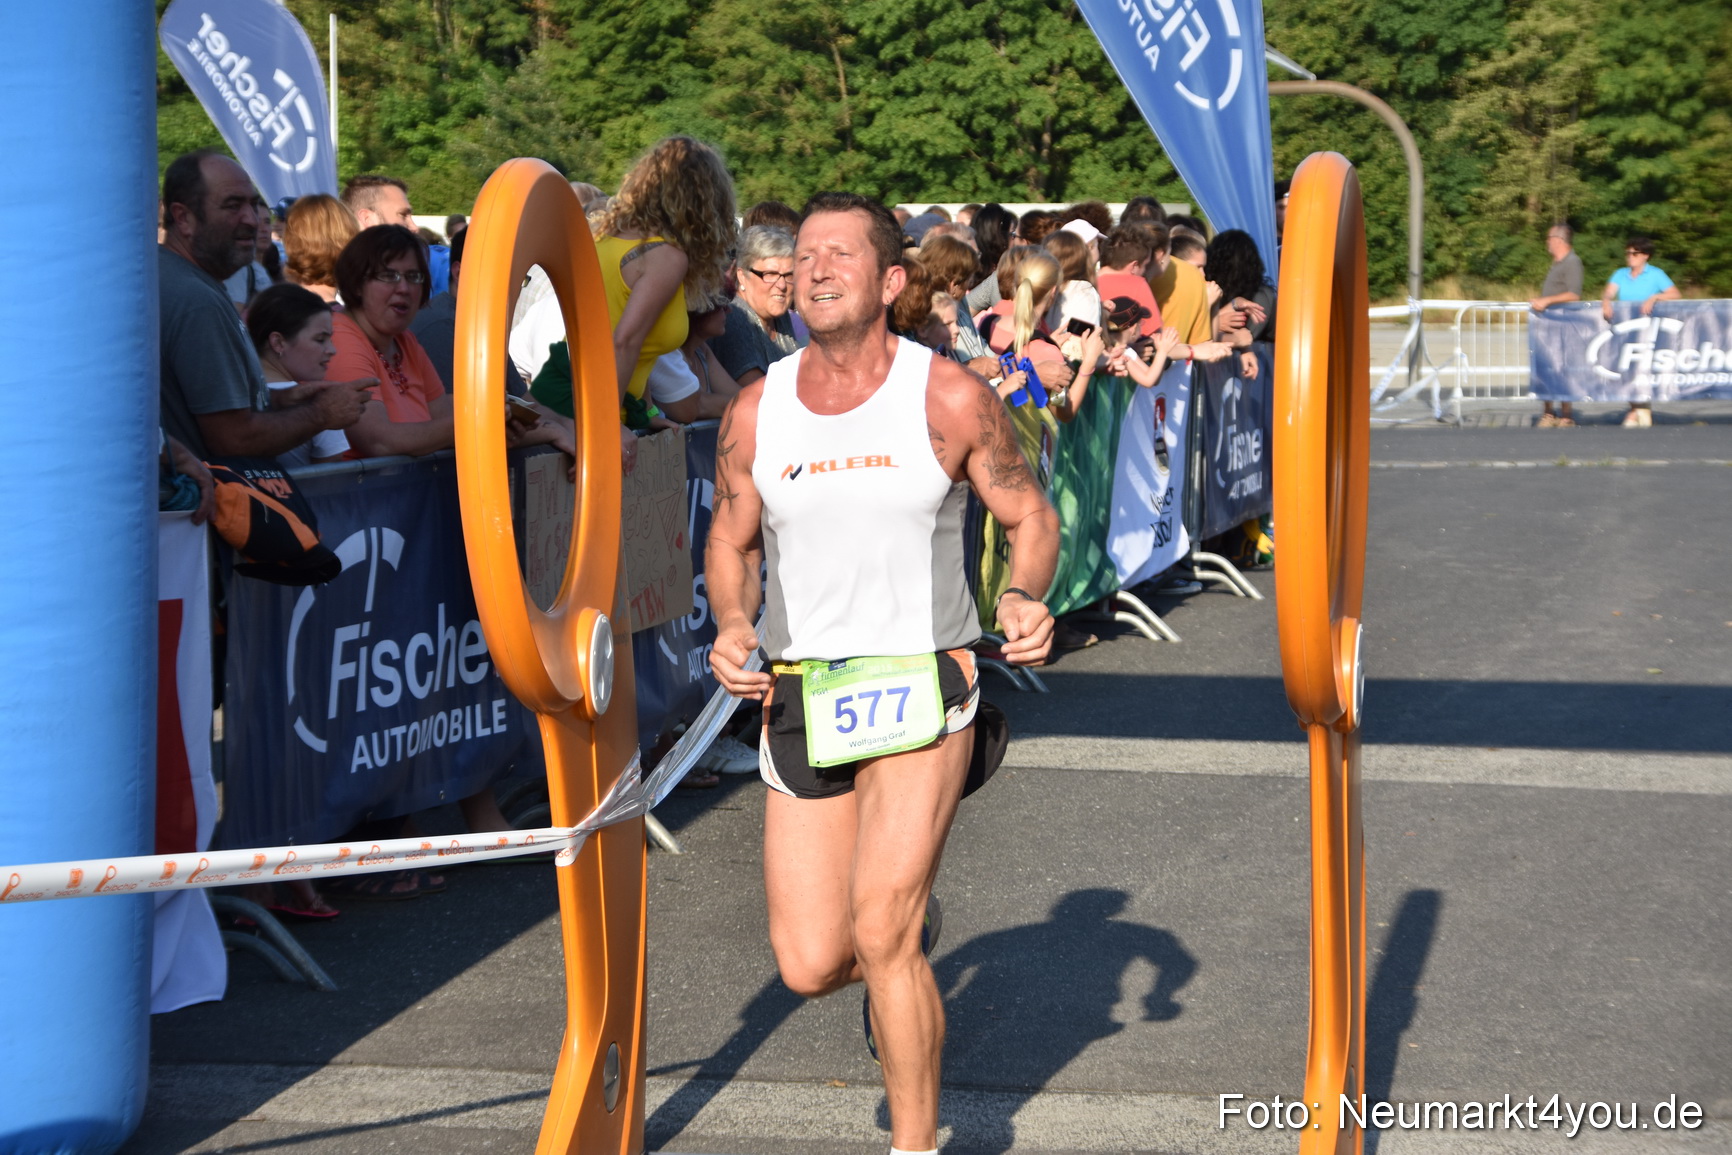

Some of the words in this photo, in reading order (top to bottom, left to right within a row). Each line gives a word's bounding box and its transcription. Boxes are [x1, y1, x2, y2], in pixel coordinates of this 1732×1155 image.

[809, 455, 899, 474] KLEBL
[328, 603, 500, 719] Fische
[821, 661, 865, 680] firmenlauf
[835, 686, 911, 734] 577
[350, 698, 507, 774] AUTOMOBILE
[848, 734, 888, 749] Wolfgang
[888, 730, 907, 741] Graf
